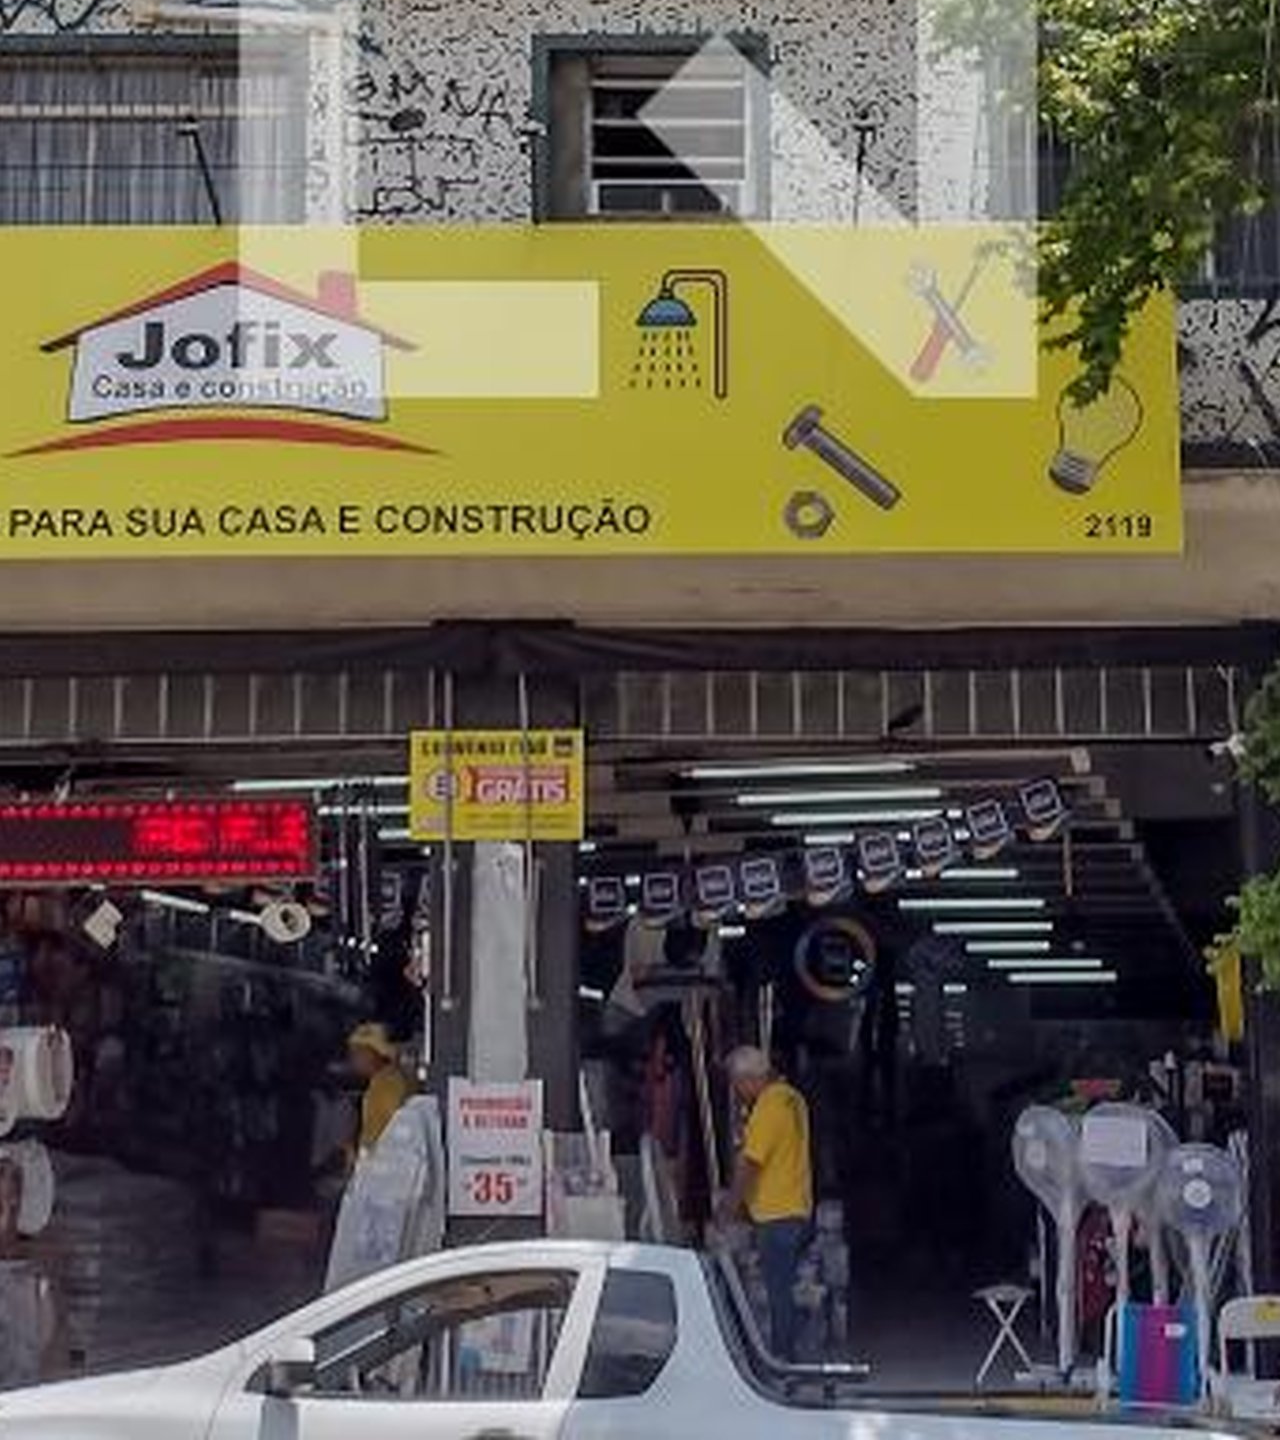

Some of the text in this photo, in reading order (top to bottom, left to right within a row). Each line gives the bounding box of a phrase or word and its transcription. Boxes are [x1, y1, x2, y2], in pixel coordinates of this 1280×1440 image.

[117, 321, 340, 370] Jofix
[92, 375, 164, 398] Casa
[175, 379, 191, 397] e
[8, 508, 114, 537] PARA
[125, 507, 206, 536] SUA
[219, 506, 325, 535] CASA
[339, 505, 360, 533] E
[375, 498, 651, 540] CONSTRUÇÃO
[1084, 513, 1152, 537] 2119
[474, 1172, 512, 1204] 35
